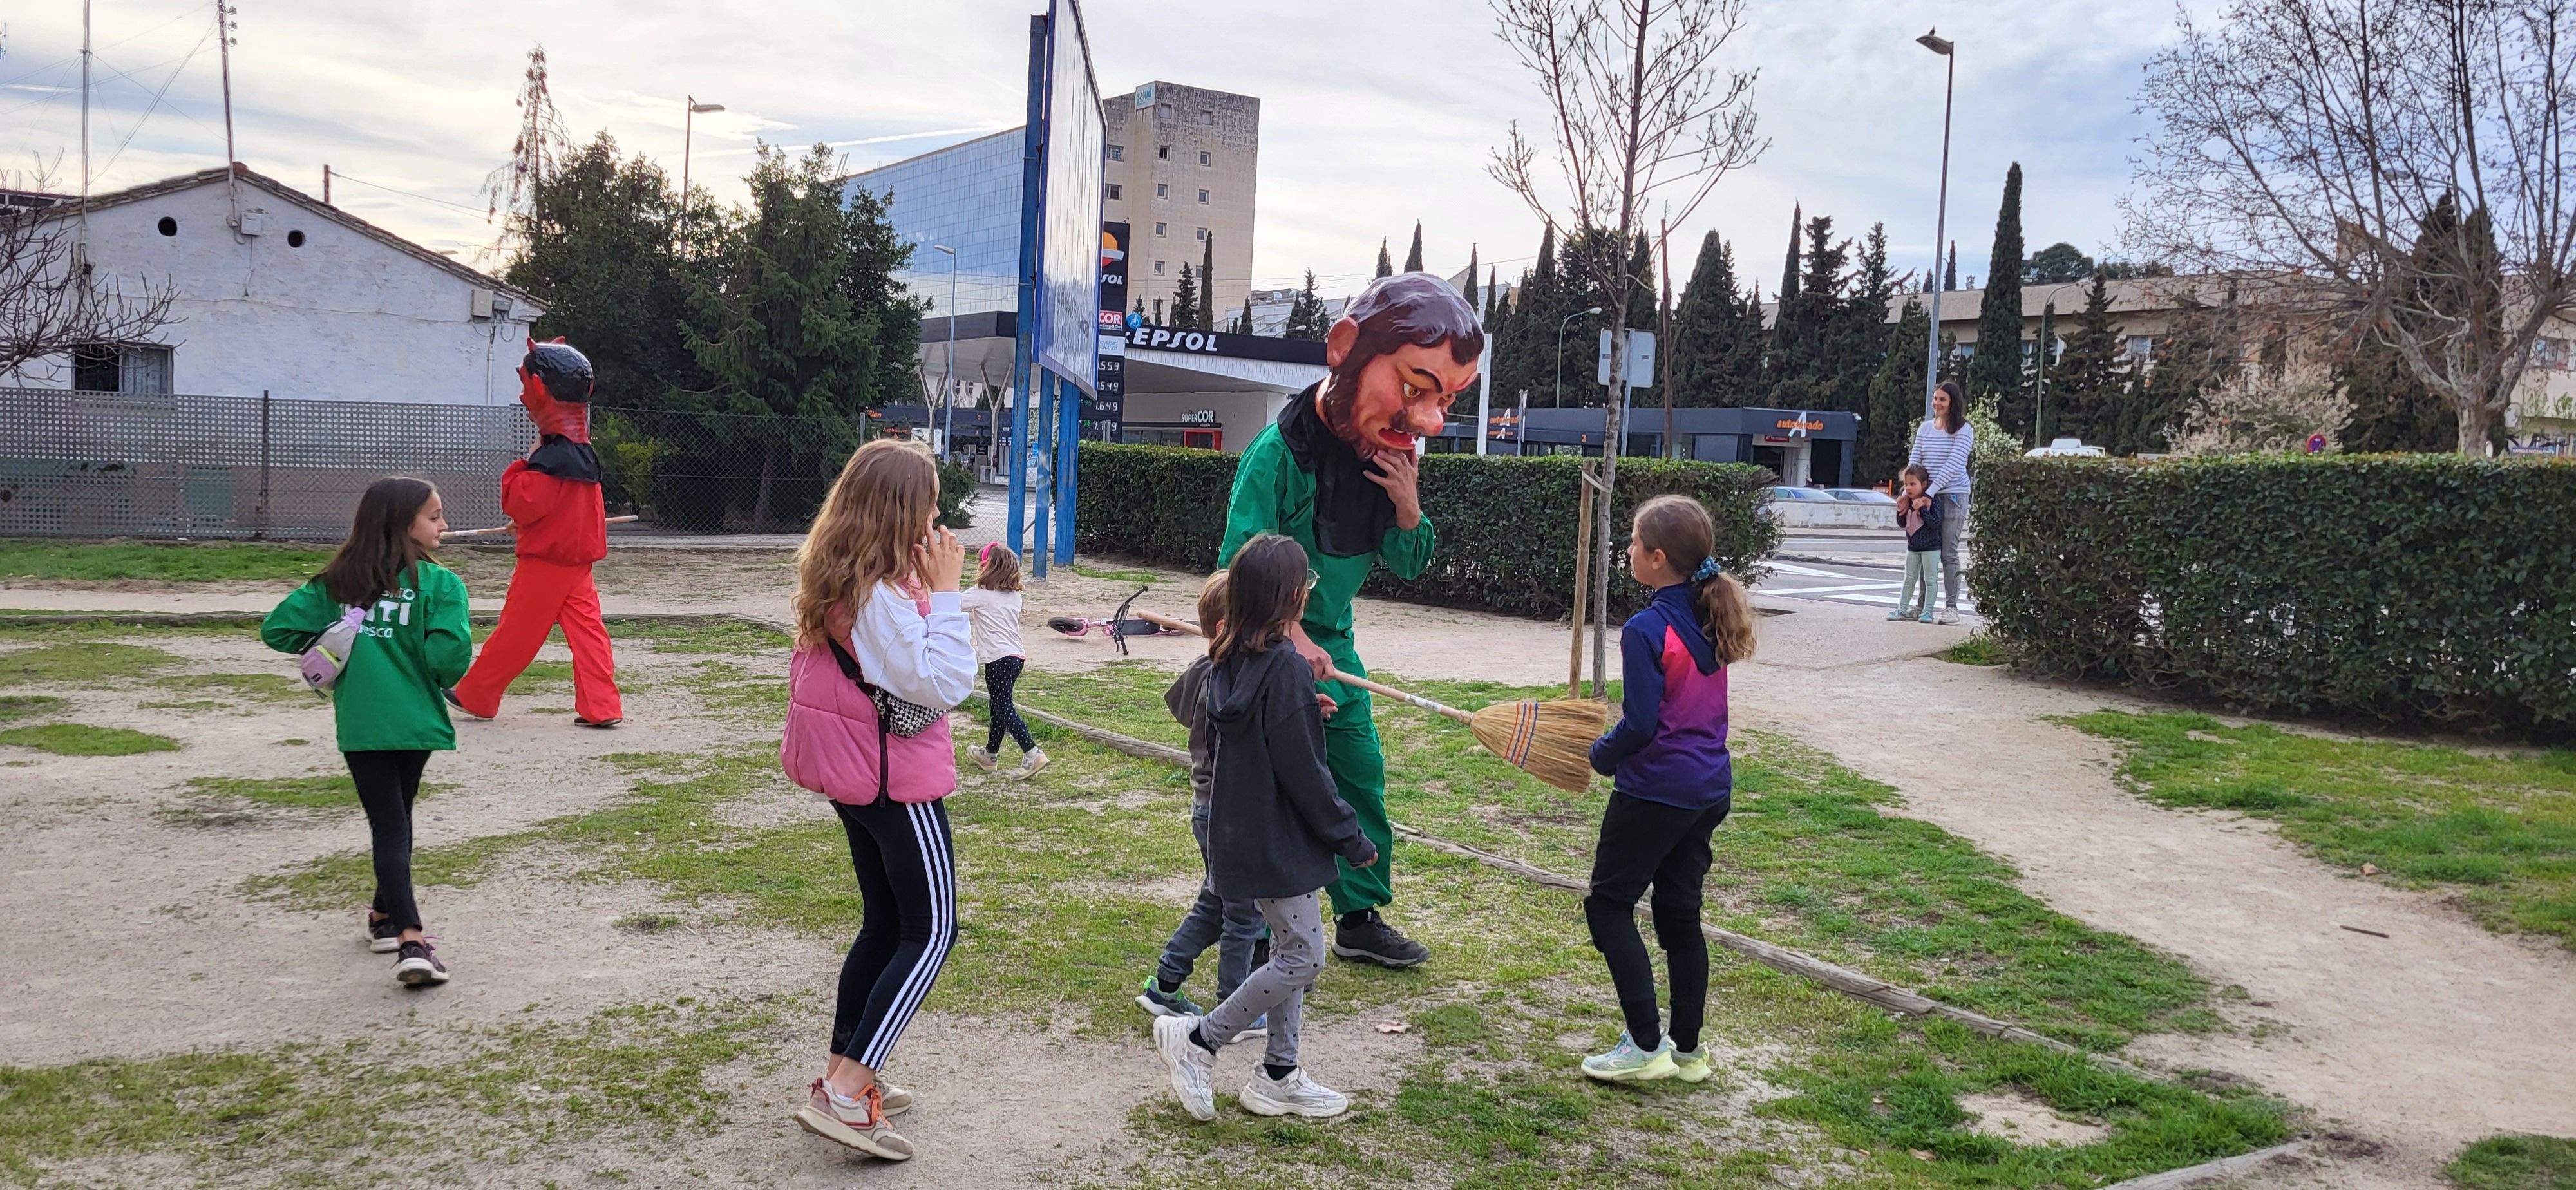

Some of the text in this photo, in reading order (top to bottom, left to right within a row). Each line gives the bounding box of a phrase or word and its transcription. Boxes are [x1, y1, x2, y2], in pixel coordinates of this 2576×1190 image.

[1101, 274, 1123, 285] SOL
[1099, 312, 1121, 324] COR
[1099, 361, 1119, 371] .559
[1098, 381, 1119, 392] .649
[1181, 410, 1214, 422] SUPERCOR
